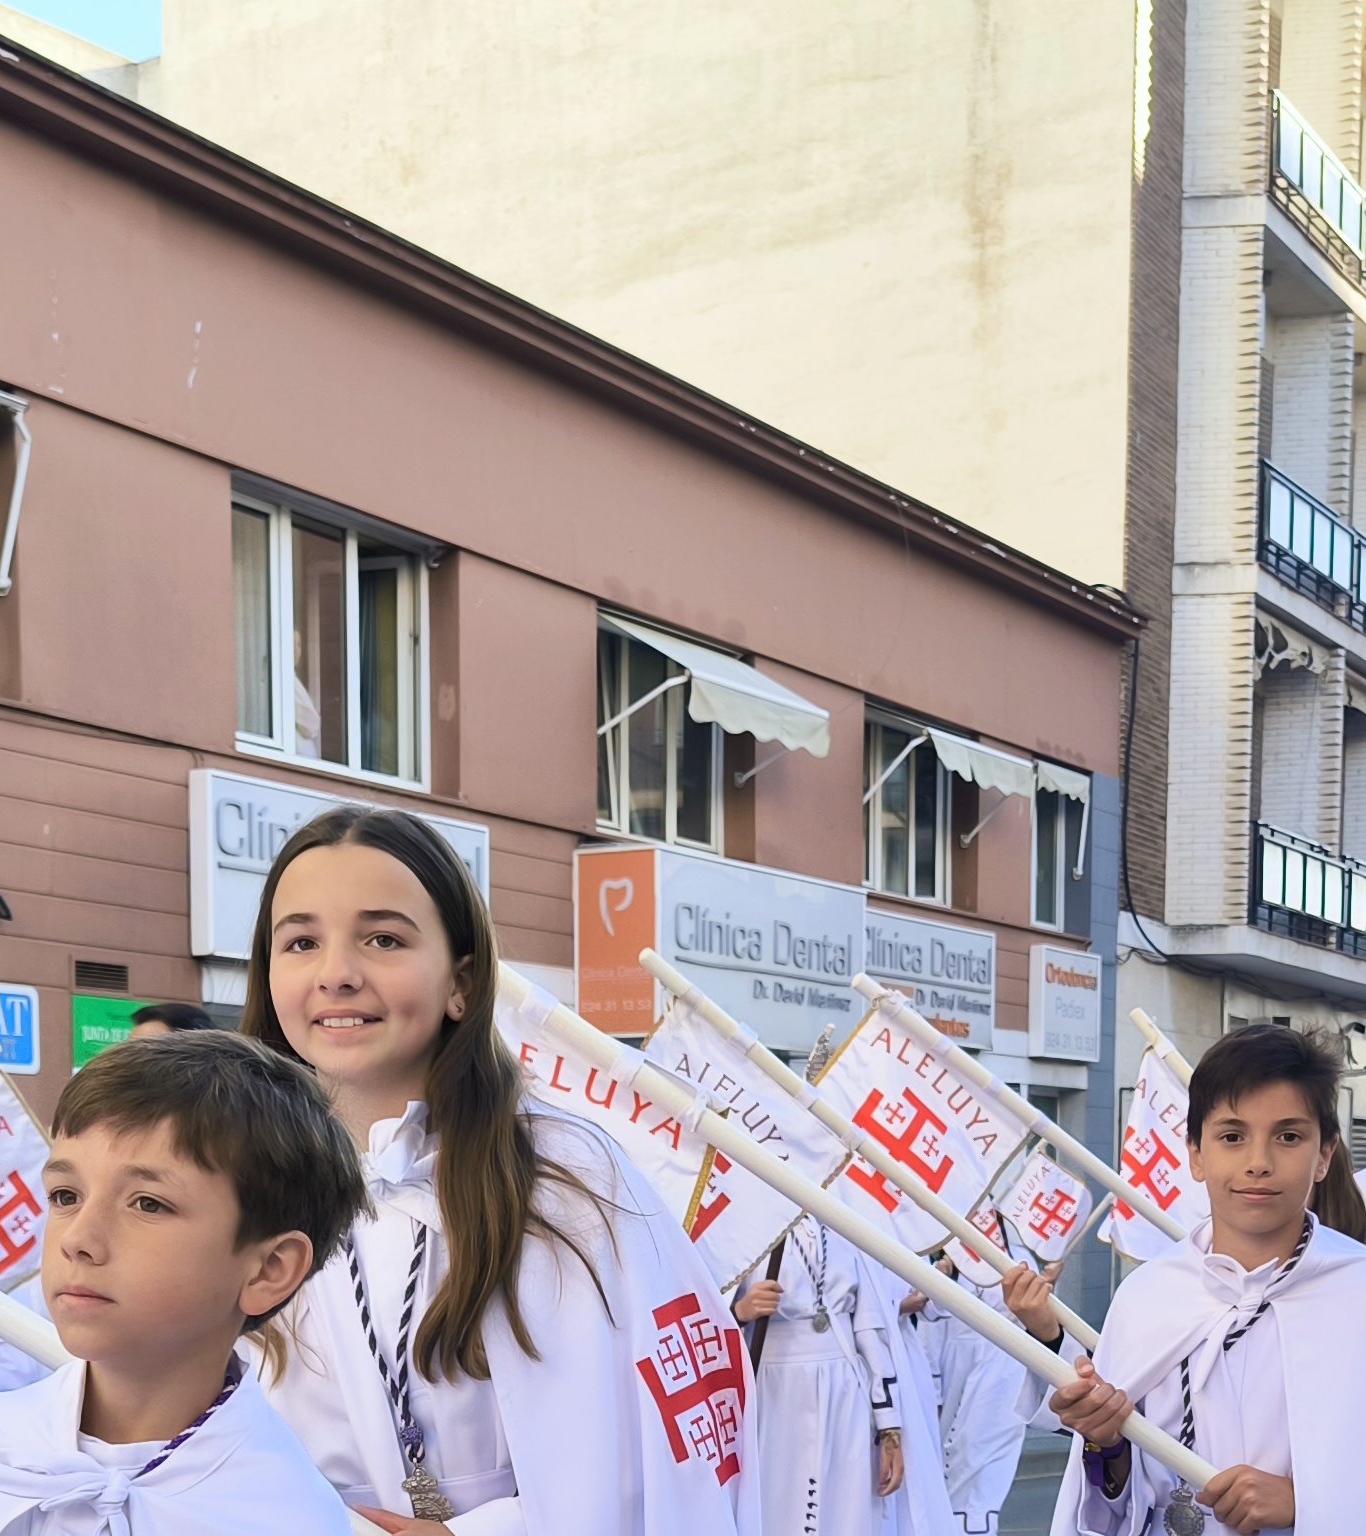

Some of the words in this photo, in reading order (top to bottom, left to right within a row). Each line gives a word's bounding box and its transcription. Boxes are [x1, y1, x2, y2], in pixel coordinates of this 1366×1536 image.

[674, 902, 762, 961] Clínica
[773, 919, 852, 977] Dental
[930, 937, 992, 986] Dental
[773, 982, 805, 1006] David
[517, 1041, 682, 1151] ELUYA
[674, 1052, 790, 1162] ALELUY
[870, 1027, 999, 1157] ALELUYA
[1135, 1078, 1188, 1139] ALEL
[1011, 1166, 1052, 1222] ALELUYA
